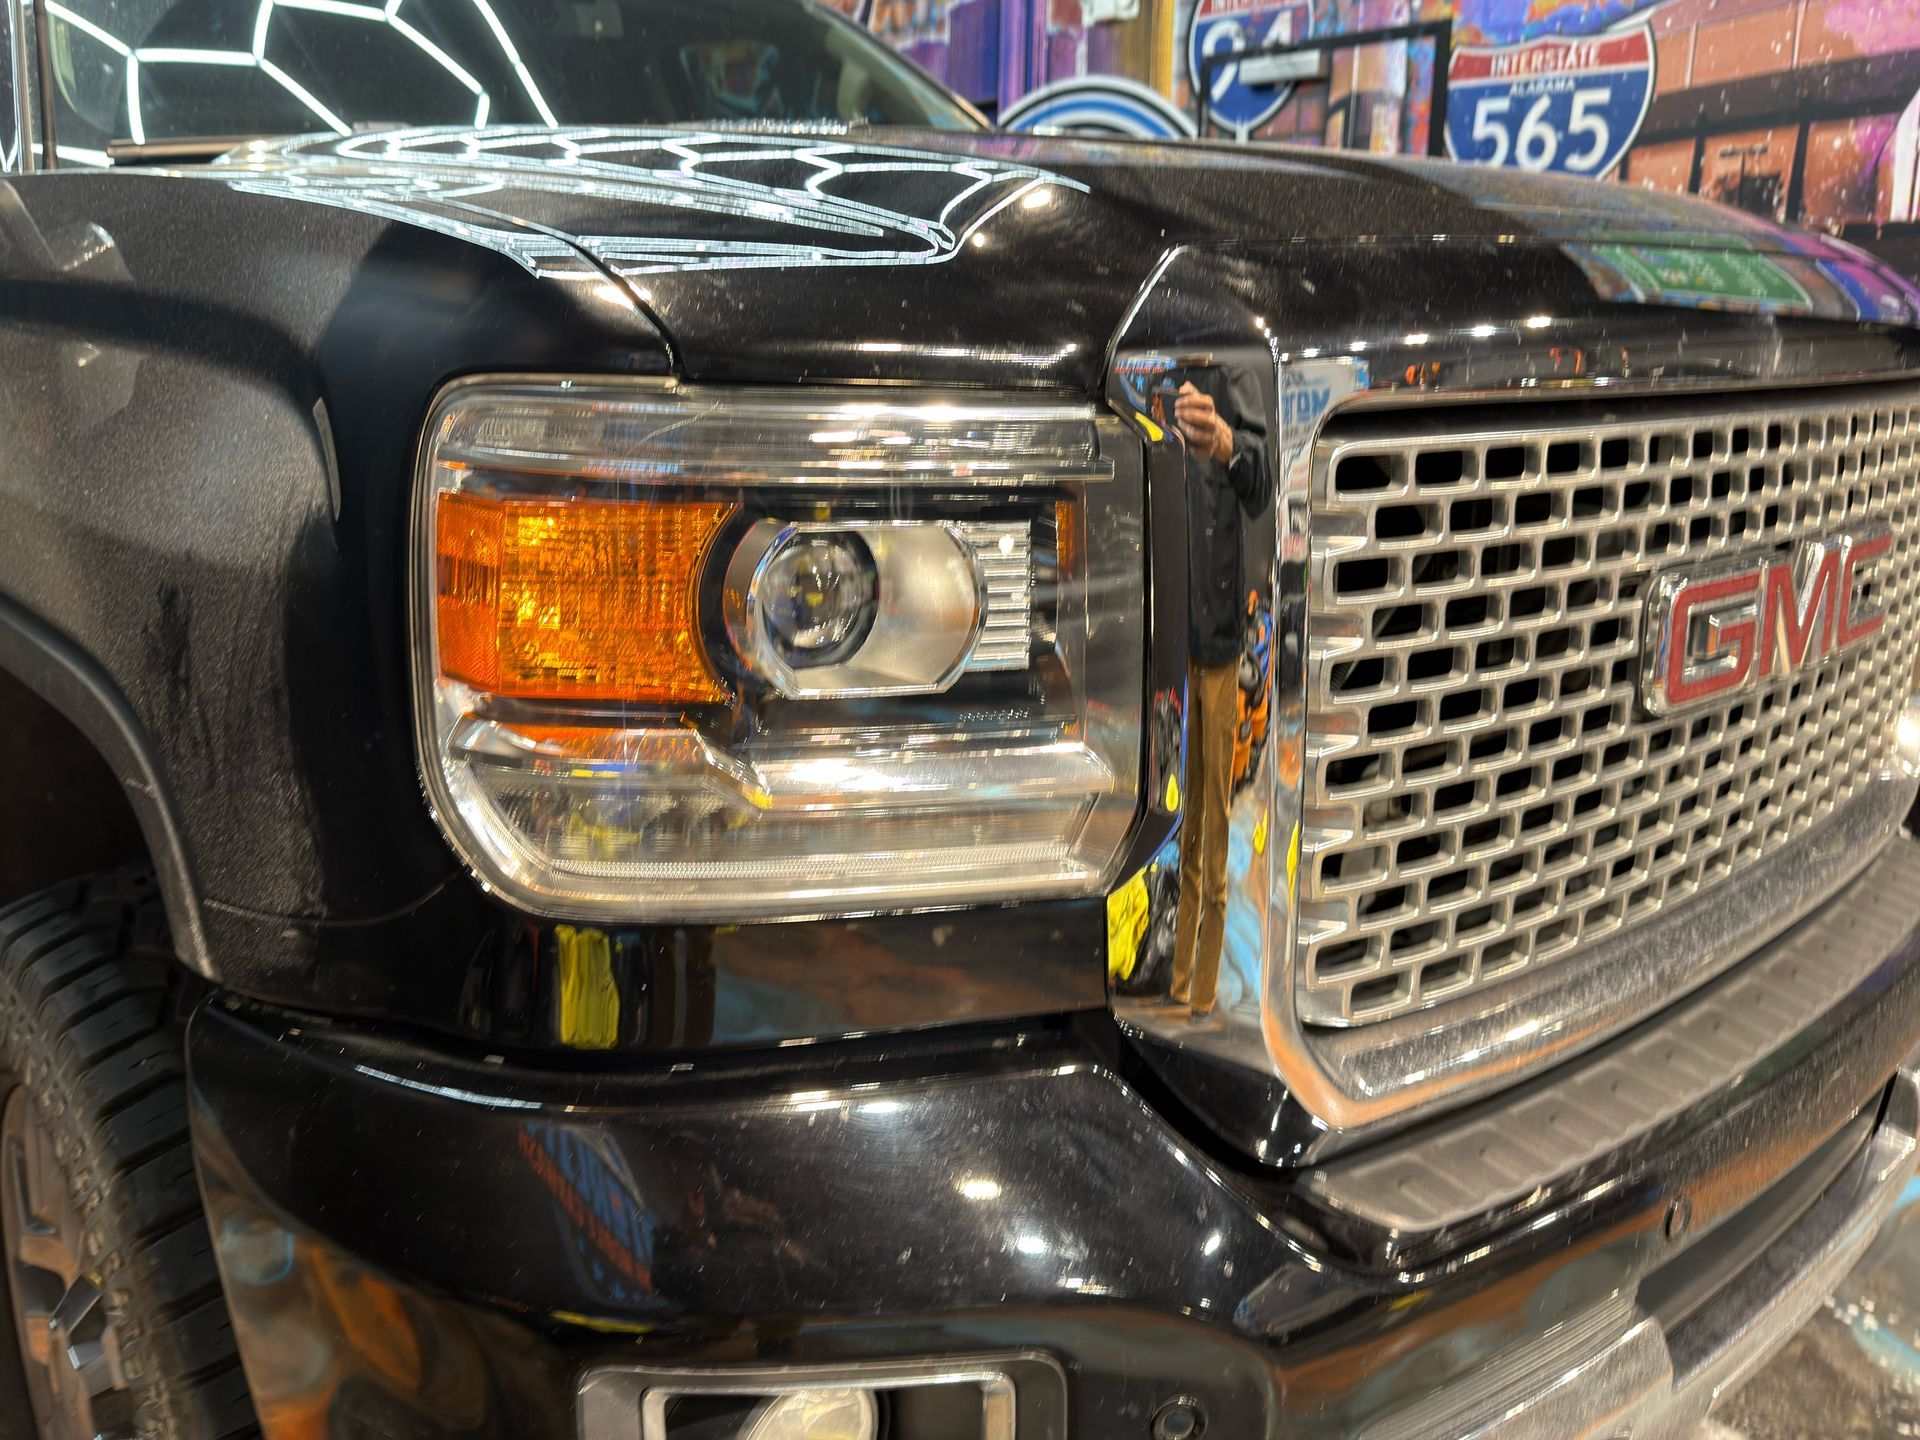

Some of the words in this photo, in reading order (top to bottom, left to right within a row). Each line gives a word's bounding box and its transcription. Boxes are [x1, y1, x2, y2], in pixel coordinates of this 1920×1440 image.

[1490, 42, 1598, 79] INTERSTATE
[1509, 77, 1577, 97] ALABAMA
[1472, 88, 1611, 172] 565
[1660, 530, 1892, 708] GMC
